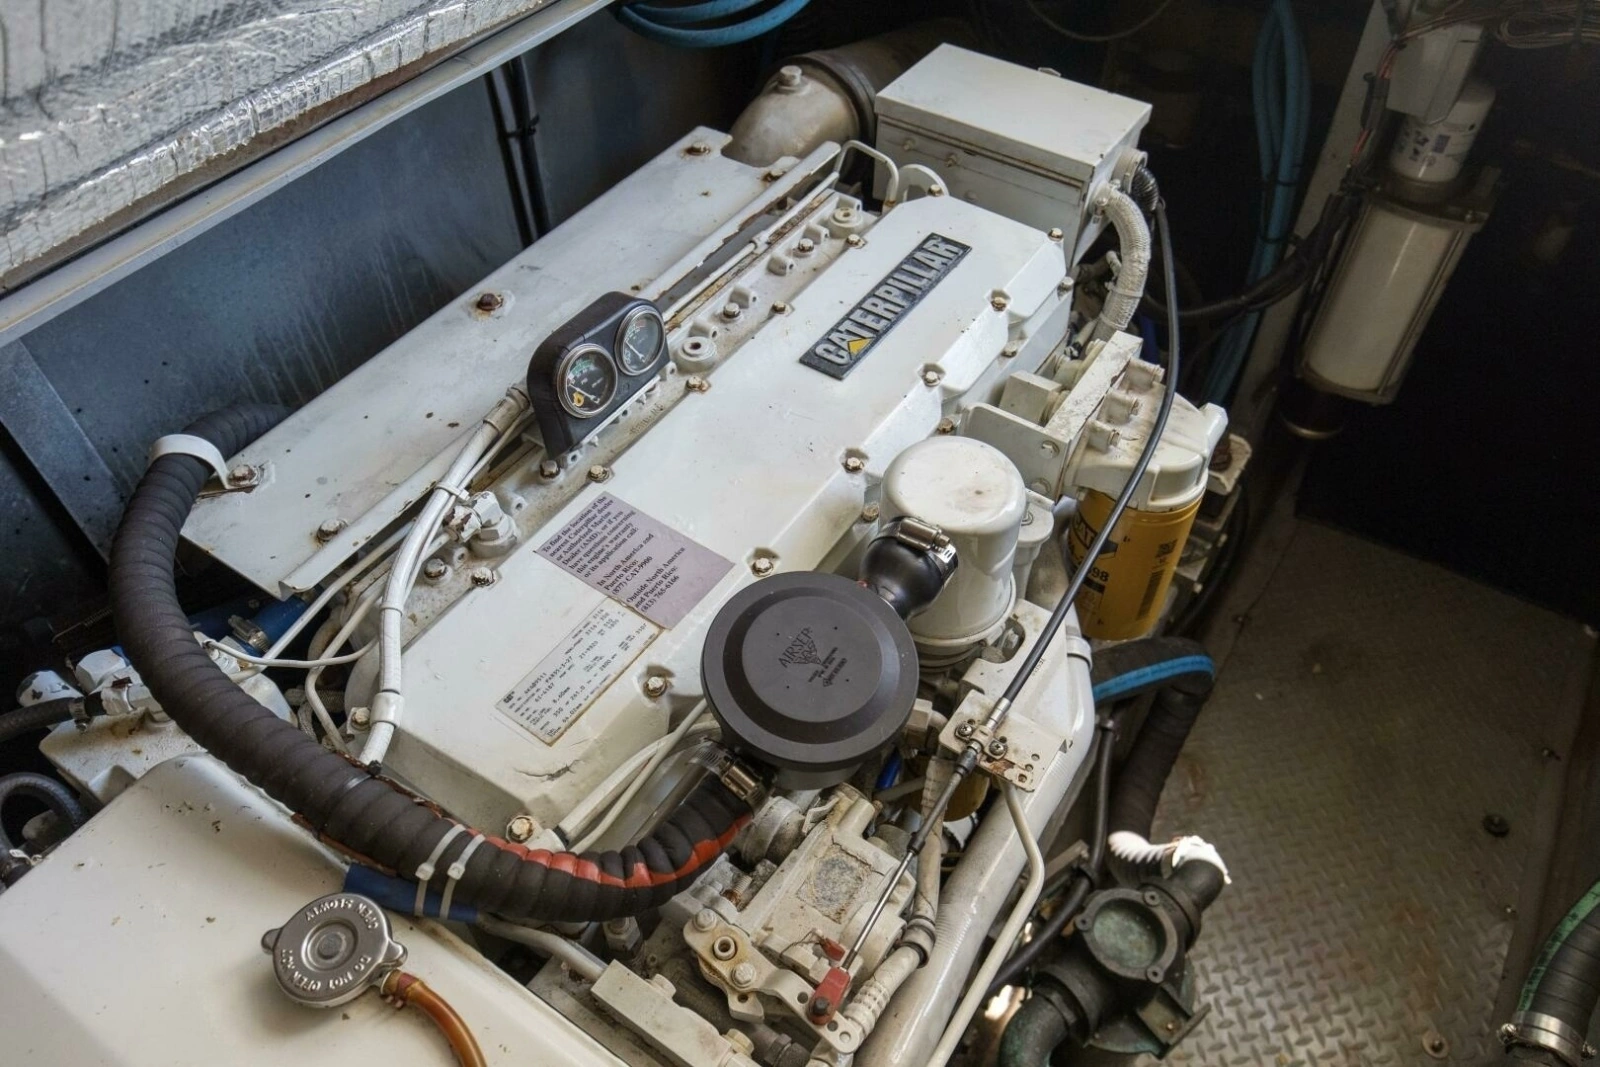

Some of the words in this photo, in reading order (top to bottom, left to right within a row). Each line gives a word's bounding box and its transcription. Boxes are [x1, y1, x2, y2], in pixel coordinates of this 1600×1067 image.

[814, 237, 962, 365] CATERPILLAR
[549, 534, 562, 546] find
[561, 527, 571, 536] the
[569, 509, 592, 528] location
[596, 496, 607, 504] the
[549, 538, 569, 557] nearest
[568, 514, 597, 539] Caterpillar
[597, 499, 613, 514] dealer
[561, 548, 581, 565] Dealer
[612, 510, 624, 521] you
[562, 527, 592, 555] Authorized
[590, 511, 611, 528] Marine
[568, 557, 583, 569] have
[582, 535, 608, 557] questions
[606, 510, 636, 536] concerning
[576, 563, 588, 574] this
[608, 522, 633, 544] warranty
[597, 538, 627, 565] application
[603, 564, 622, 580] North
[620, 544, 643, 564] America
[642, 533, 654, 544] and
[603, 573, 624, 590] Puerto
[626, 583, 648, 602] Outside
[645, 568, 664, 584] North
[662, 547, 685, 568] America
[634, 596, 646, 608] and
[643, 579, 663, 598] Puerto
[640, 598, 656, 612] (813)
